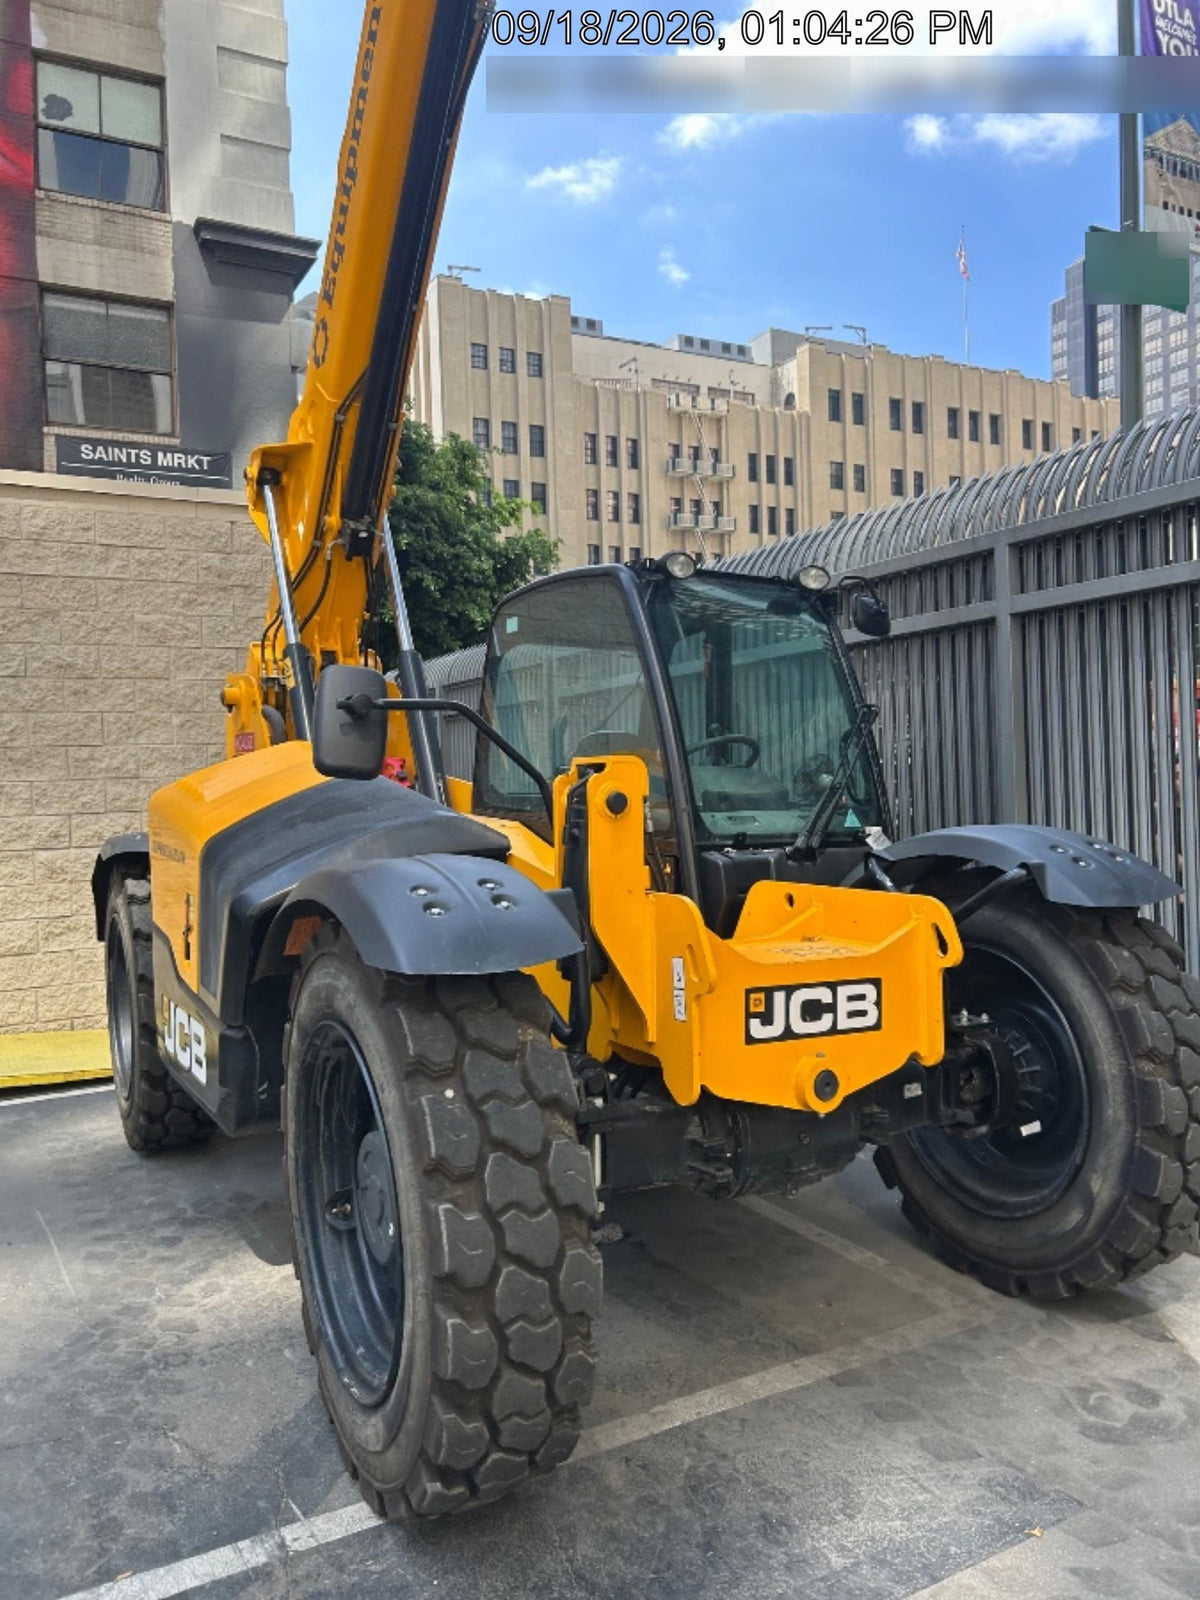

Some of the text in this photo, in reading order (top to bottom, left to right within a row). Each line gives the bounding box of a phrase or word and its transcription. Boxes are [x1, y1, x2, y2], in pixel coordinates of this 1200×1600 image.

[320, 0, 383, 309] Equipmen
[80, 444, 212, 470] SAINTS MRKT
[164, 1000, 207, 1086] JCB
[749, 982, 880, 1040] JCB
